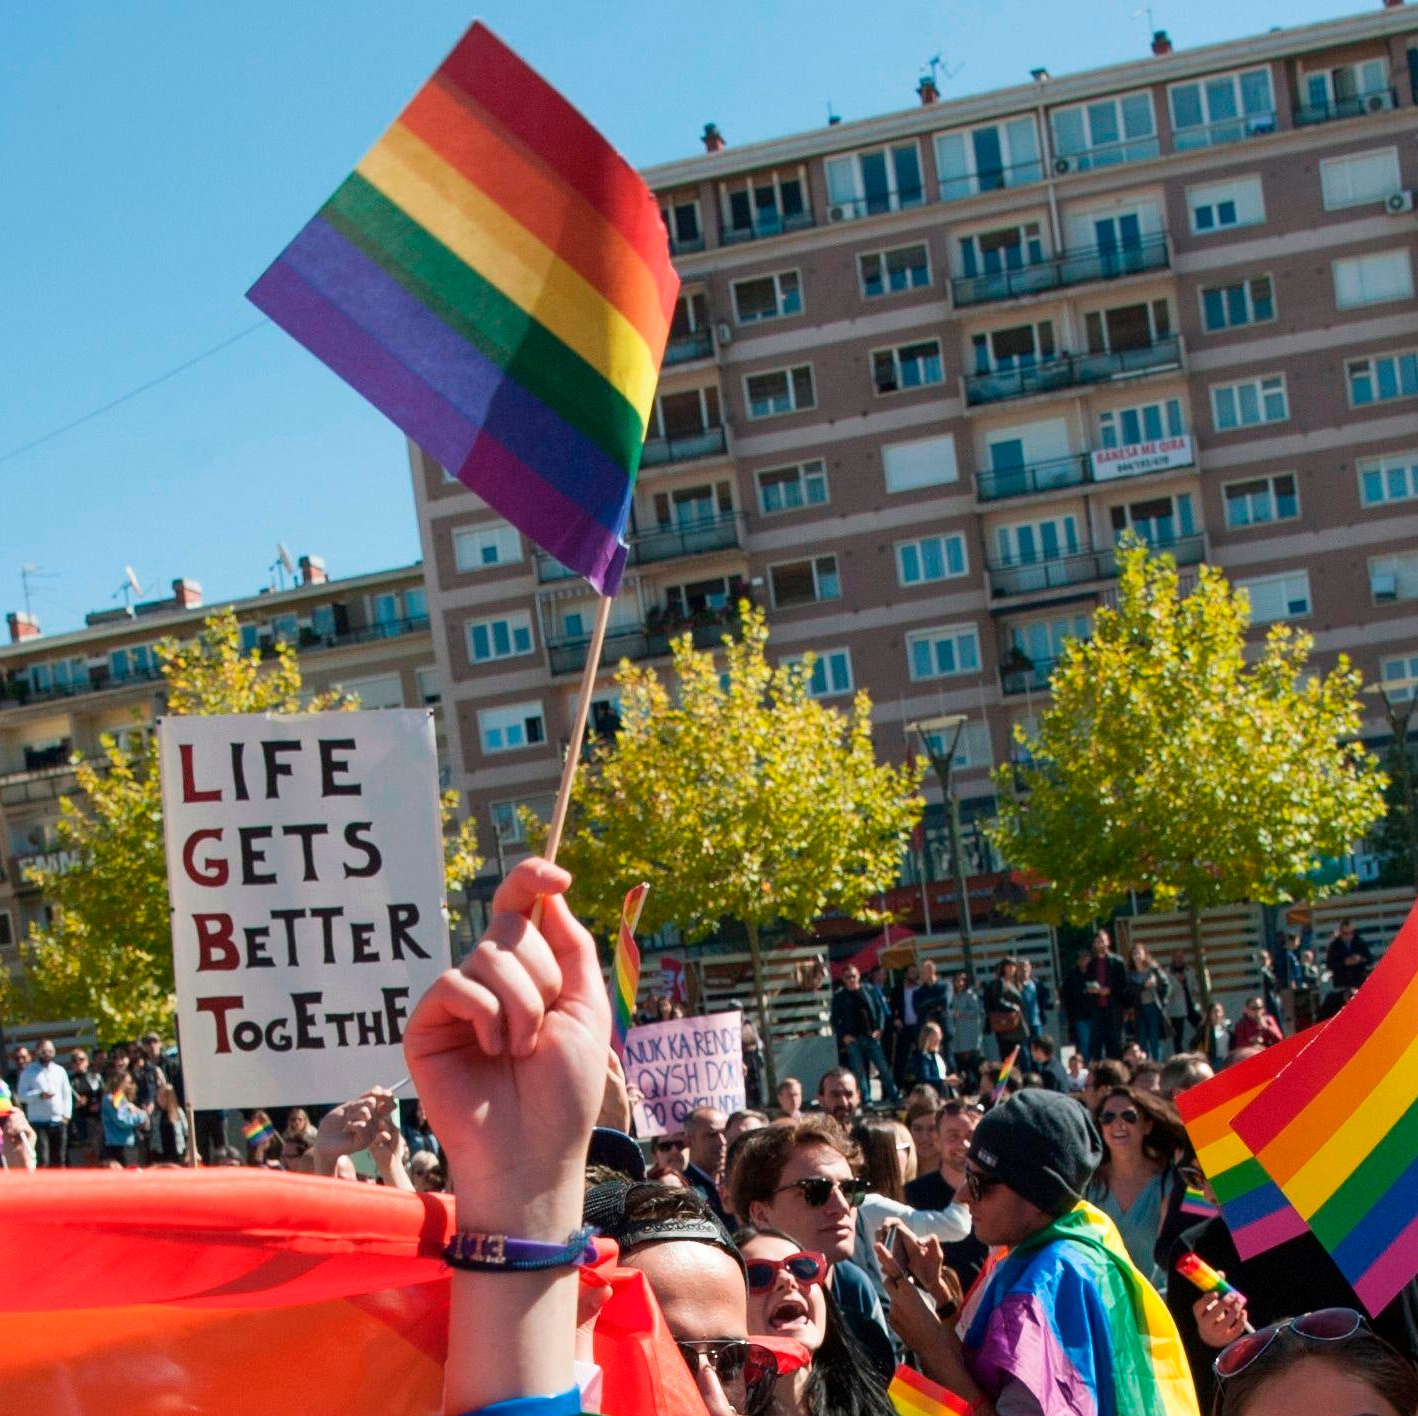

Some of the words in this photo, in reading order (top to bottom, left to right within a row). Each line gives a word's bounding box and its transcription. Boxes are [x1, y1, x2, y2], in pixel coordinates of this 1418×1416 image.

[179, 737, 363, 803] LIFE
[182, 820, 383, 888] GETS
[196, 986, 409, 1056] TOGETHE
[625, 1035, 666, 1066] NUK
[667, 1031, 693, 1060] KA
[638, 1061, 700, 1101] QYSH
[643, 1101, 667, 1129] PO
